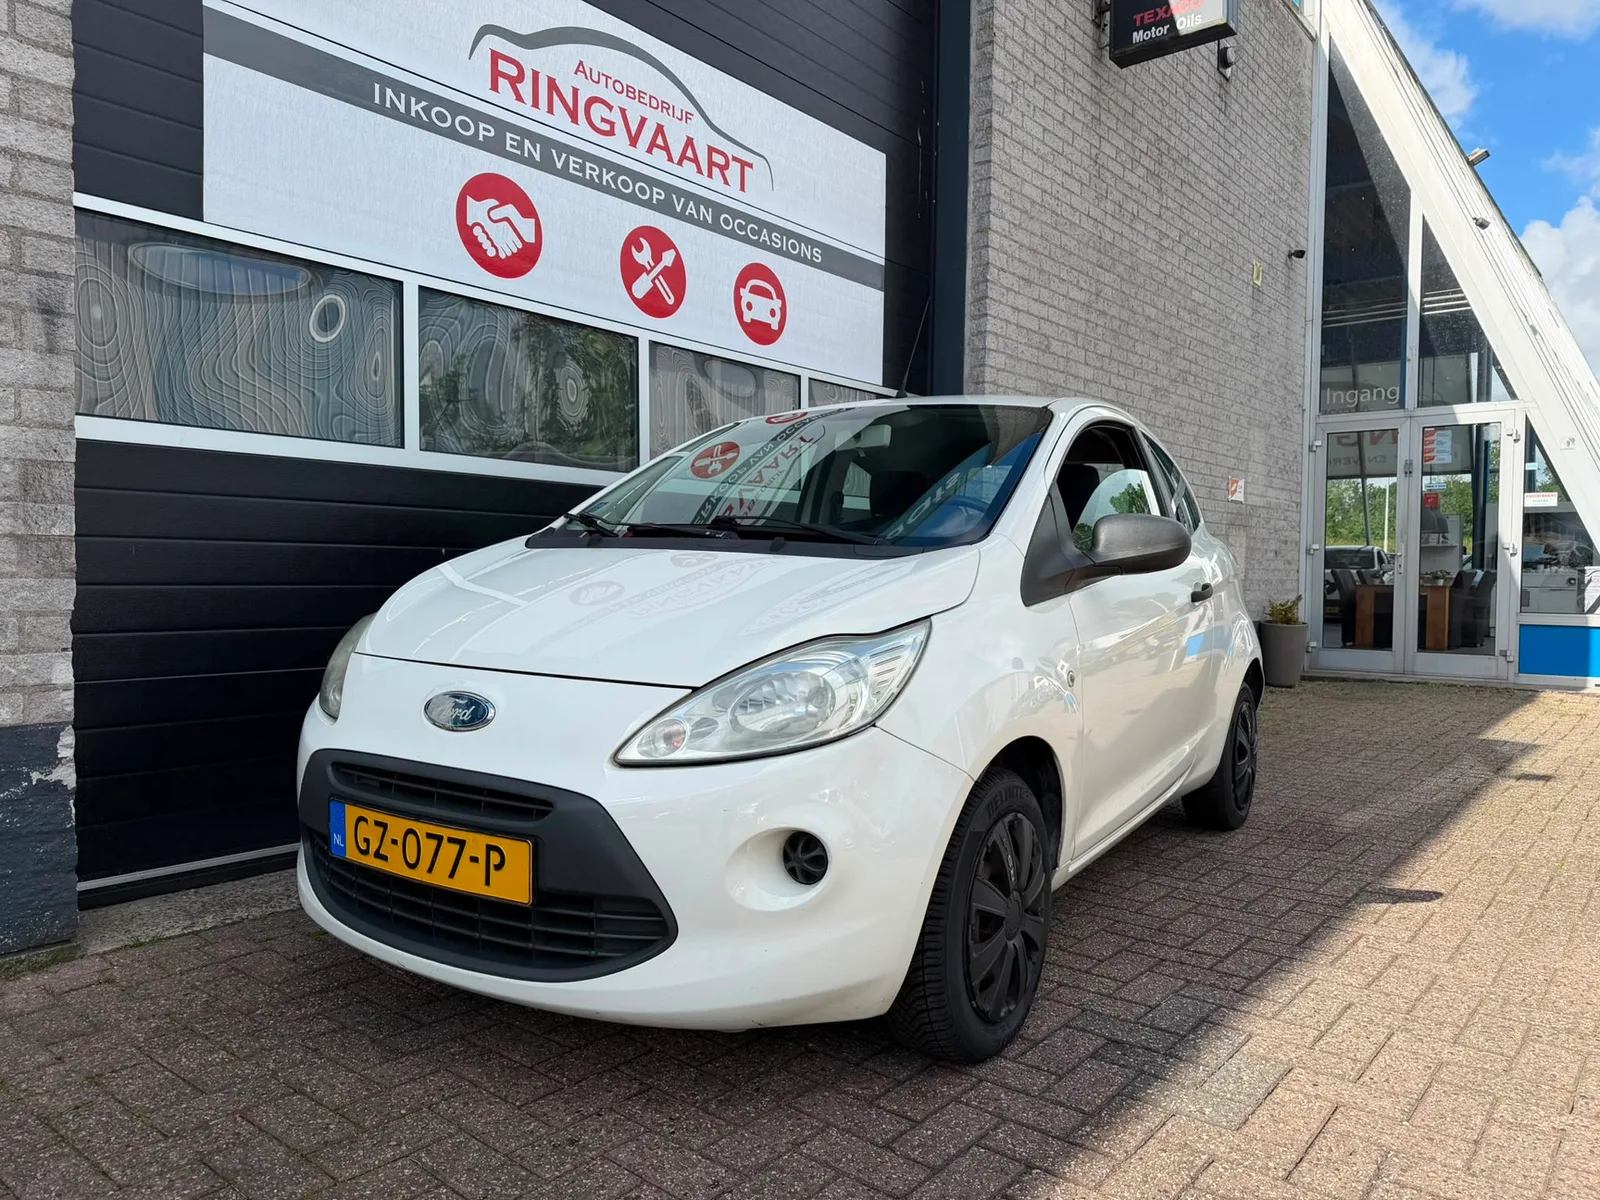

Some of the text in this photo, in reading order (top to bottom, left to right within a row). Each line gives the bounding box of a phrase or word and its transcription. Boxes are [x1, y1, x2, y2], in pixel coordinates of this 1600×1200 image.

[1132, 13, 1202, 44] Motor Oils
[488, 48, 754, 193] RINGVAART
[573, 60, 694, 125] AUTOBEDRIJF
[373, 83, 823, 264] INKOOP EN VERKOOP VAN OCCASIONS
[1326, 386, 1400, 408] Ingang
[333, 833, 345, 848] NL
[353, 815, 506, 887] GZ-077-P
